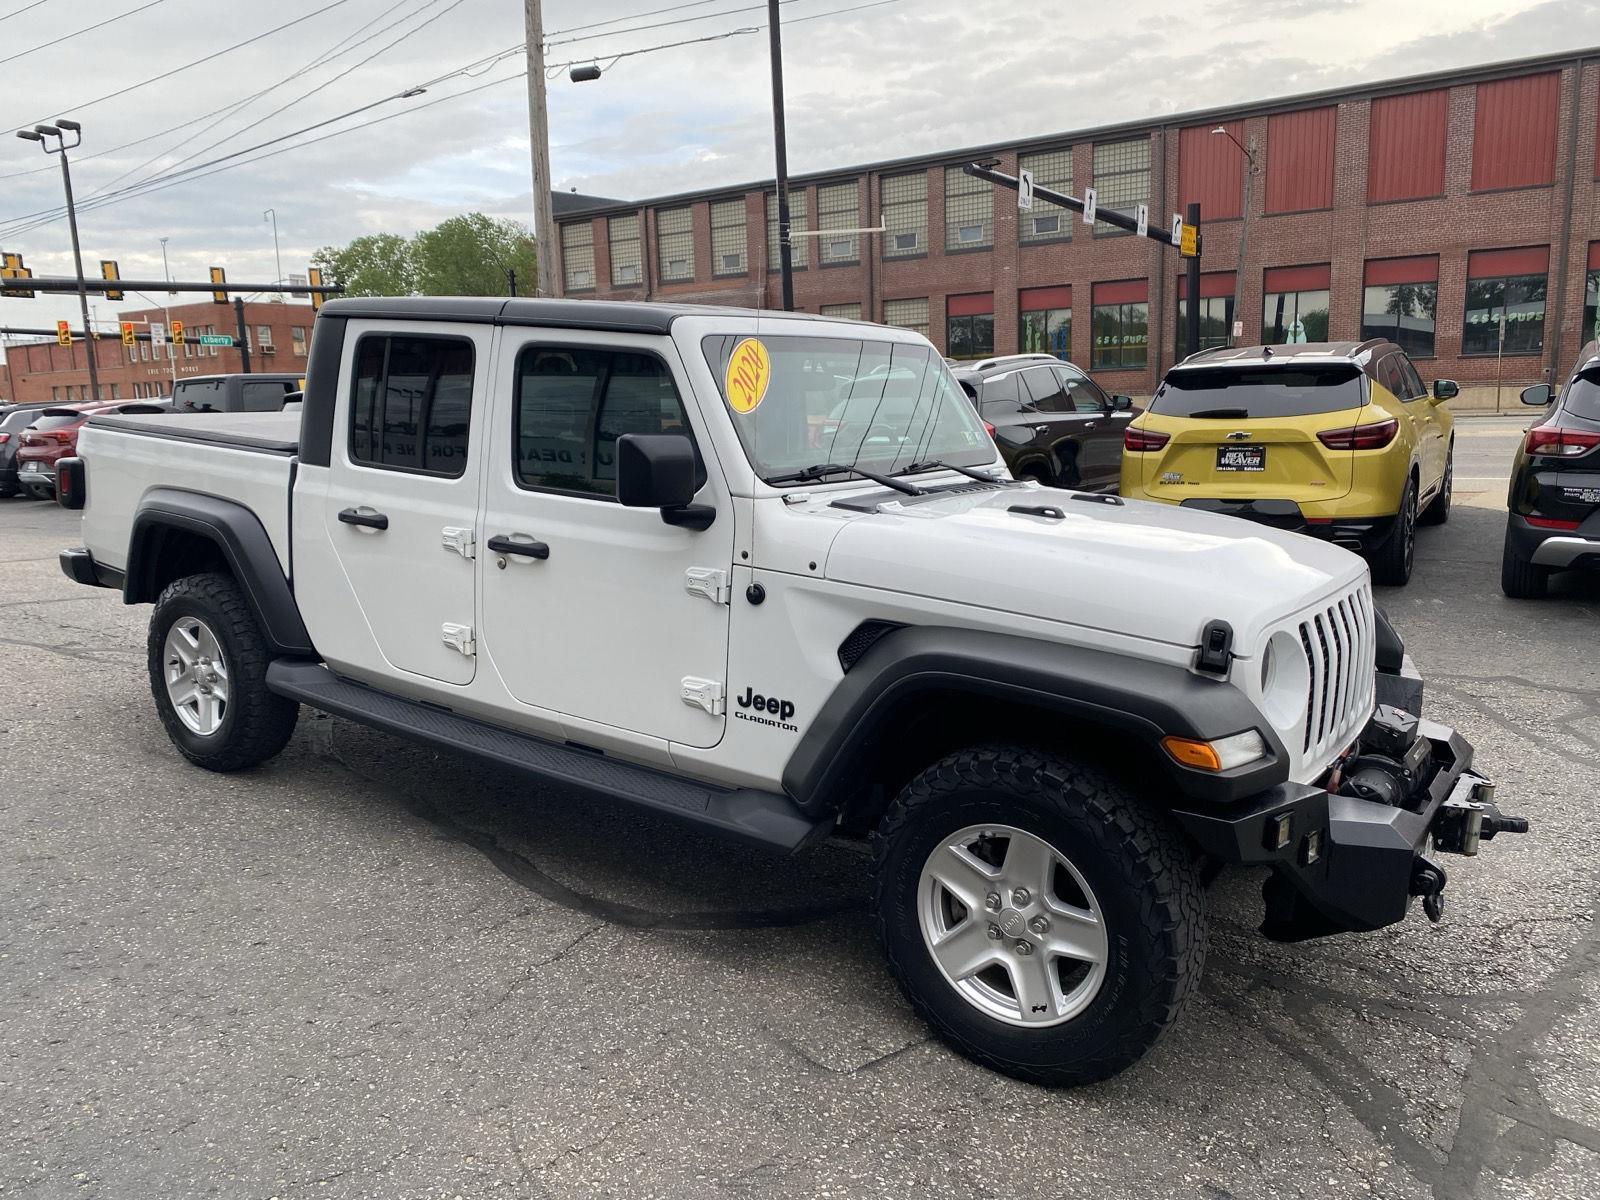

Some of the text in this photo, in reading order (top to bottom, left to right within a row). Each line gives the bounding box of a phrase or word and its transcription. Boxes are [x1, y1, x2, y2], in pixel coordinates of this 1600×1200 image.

[203, 337, 229, 345] Liberty
[733, 344, 764, 406] 2020
[737, 686, 795, 721] Jeep
[735, 711, 798, 732] GLADIATOR
